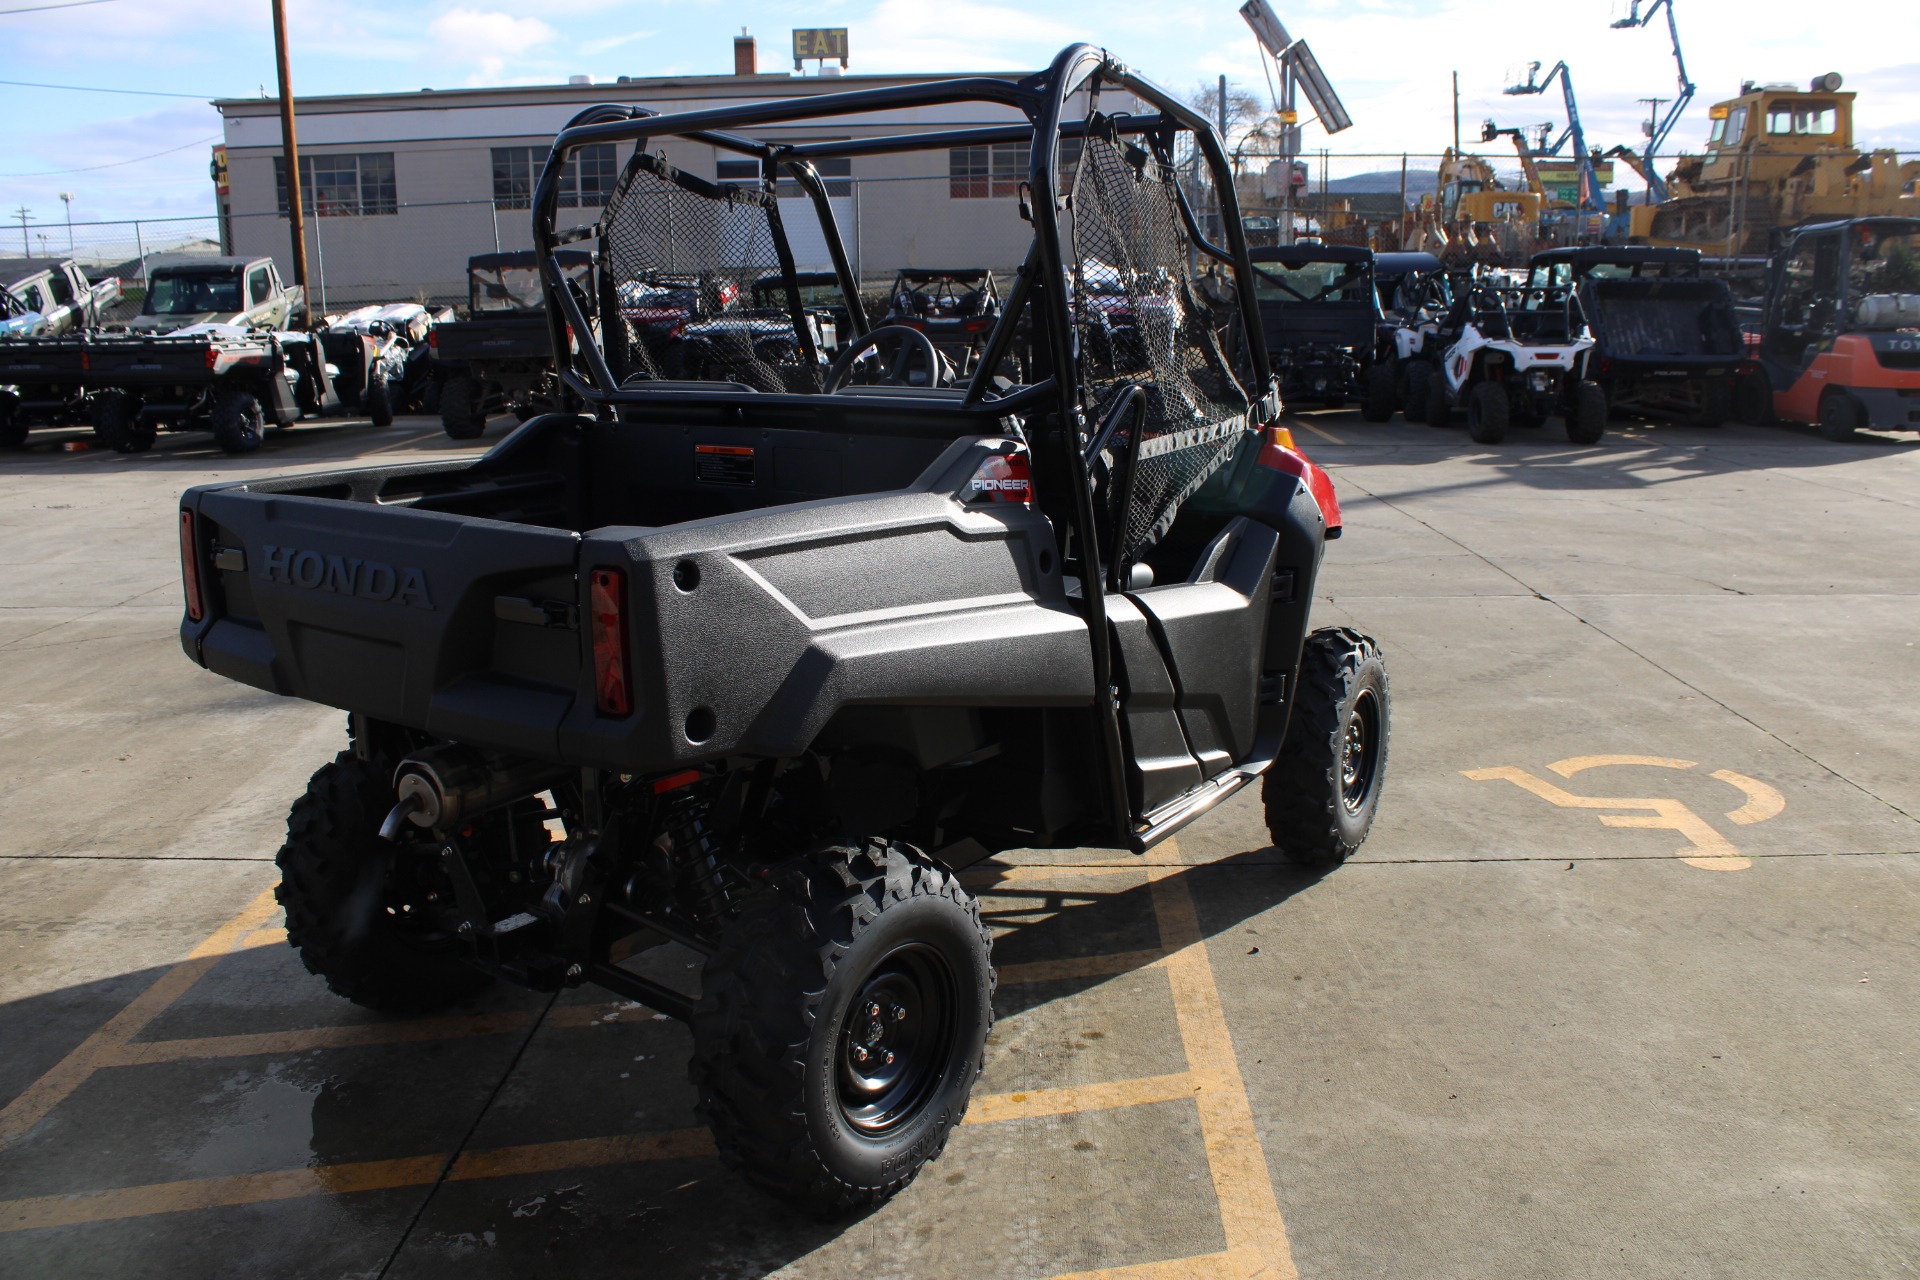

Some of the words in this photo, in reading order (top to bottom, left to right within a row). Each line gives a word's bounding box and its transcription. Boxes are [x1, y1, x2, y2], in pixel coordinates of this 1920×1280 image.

[795, 30, 846, 55] EAT
[1493, 203, 1519, 218] CAT
[971, 479, 1029, 491] PIONEER
[262, 544, 437, 611] HONDA
